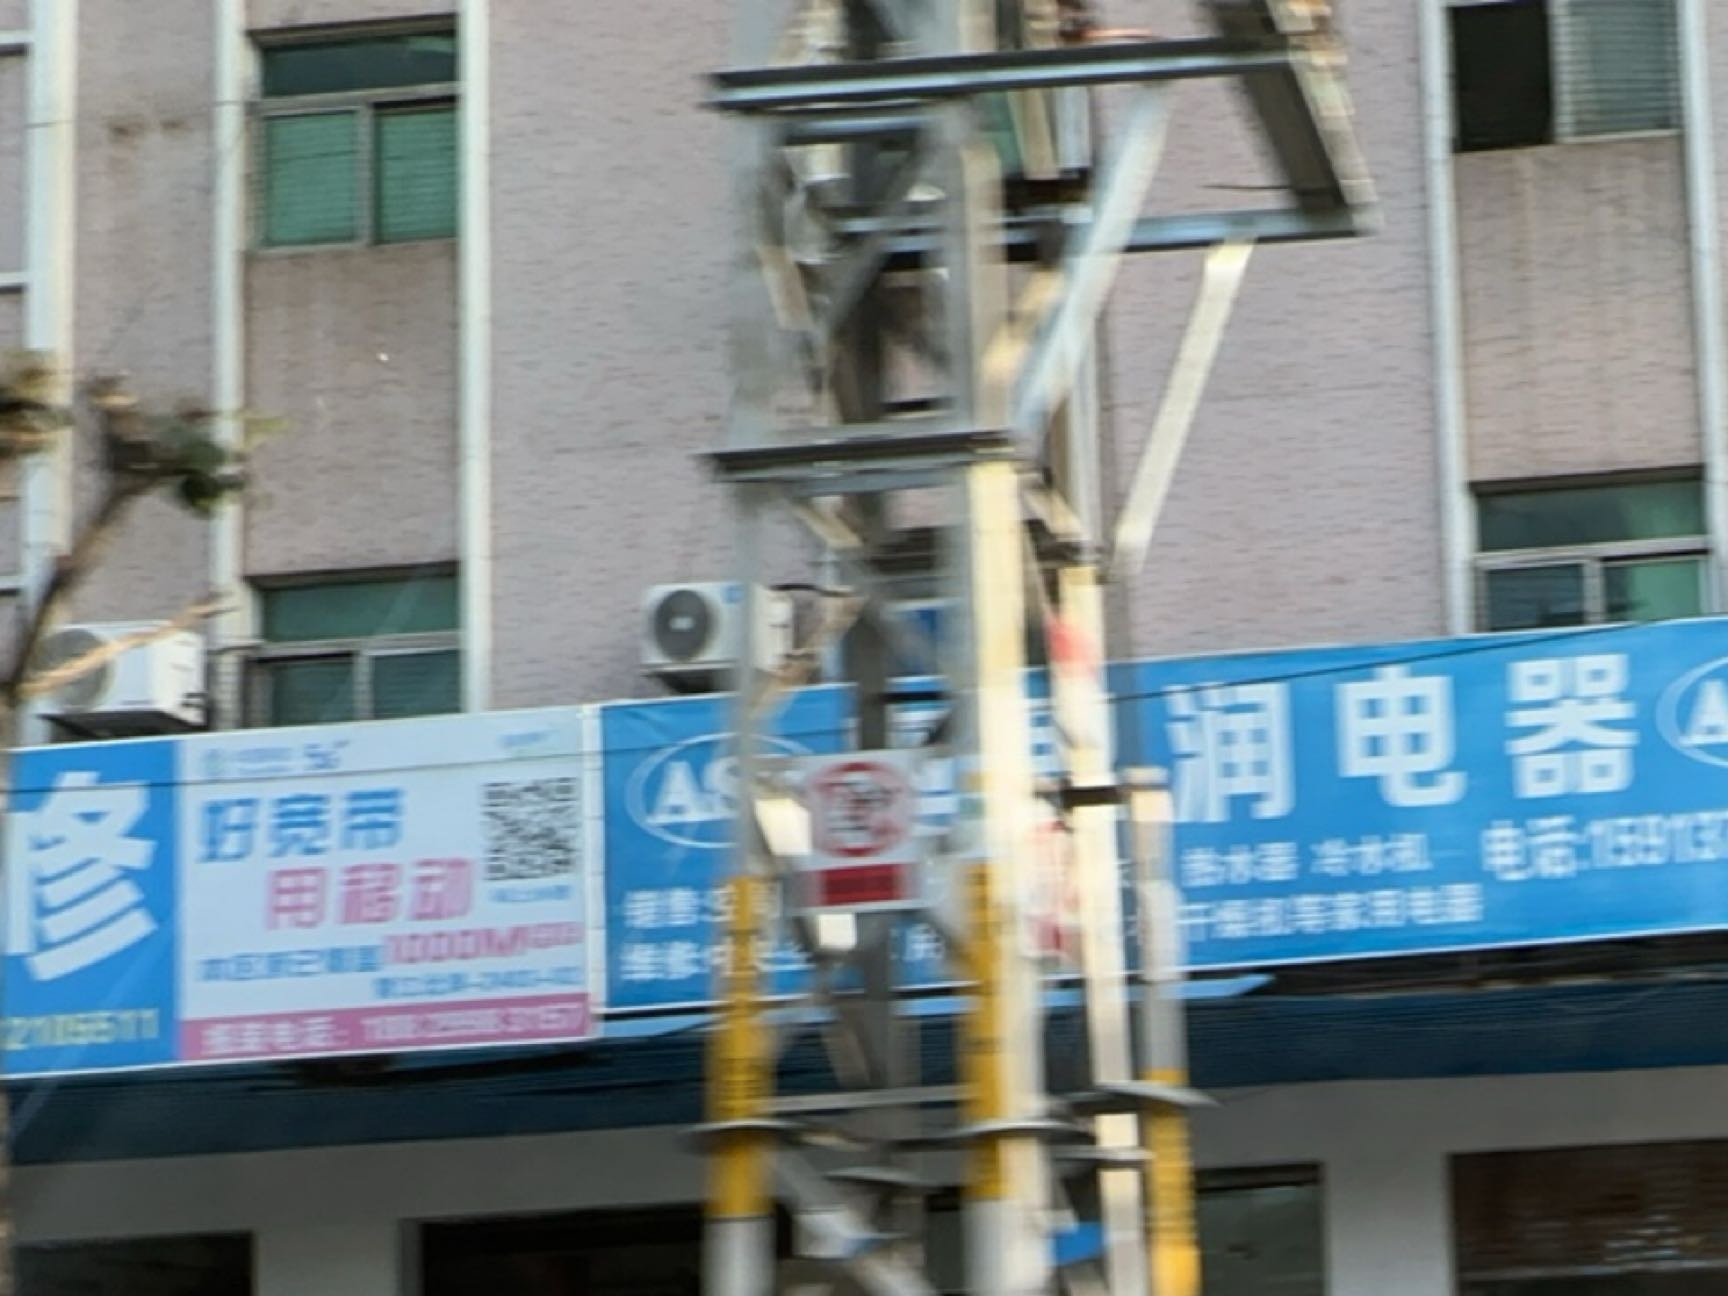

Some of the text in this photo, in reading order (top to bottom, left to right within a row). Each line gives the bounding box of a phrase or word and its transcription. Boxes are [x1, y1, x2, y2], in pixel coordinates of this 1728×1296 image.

[2, 770, 158, 982] 修
[265, 857, 475, 931] 用移动
